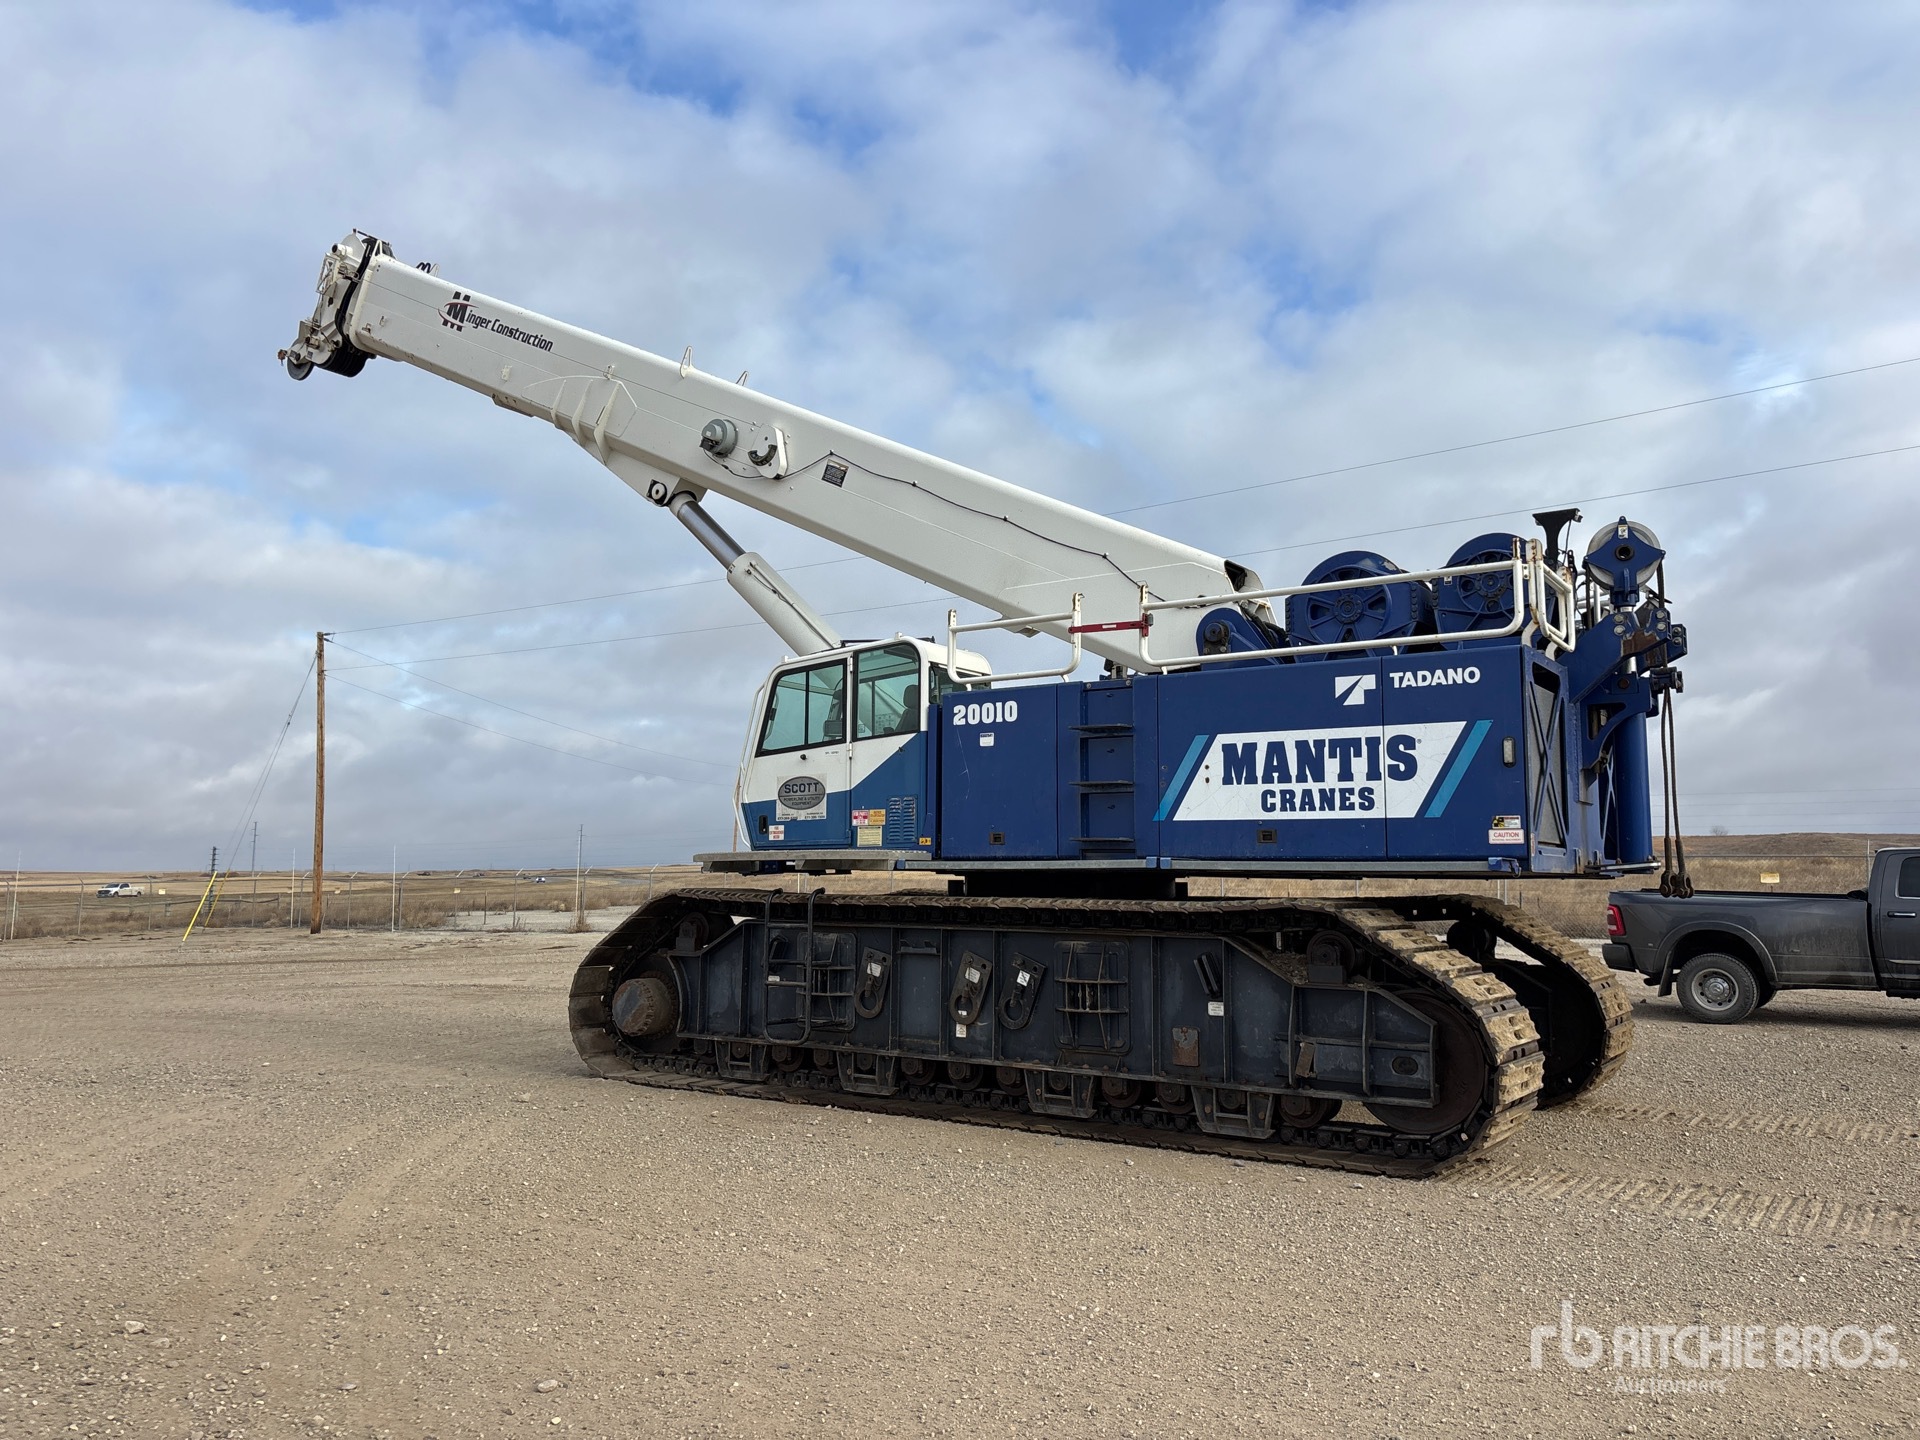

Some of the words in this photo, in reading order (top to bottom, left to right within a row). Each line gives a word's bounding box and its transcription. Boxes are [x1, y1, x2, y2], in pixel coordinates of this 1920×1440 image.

[441, 291, 492, 332] Minger
[491, 318, 554, 352] Construction
[1389, 666, 1481, 688] TADANO
[953, 700, 1018, 726] 20010
[1221, 734, 1418, 786] MANTIS
[784, 782, 819, 794] SCOTT
[1260, 786, 1375, 813] CRANES
